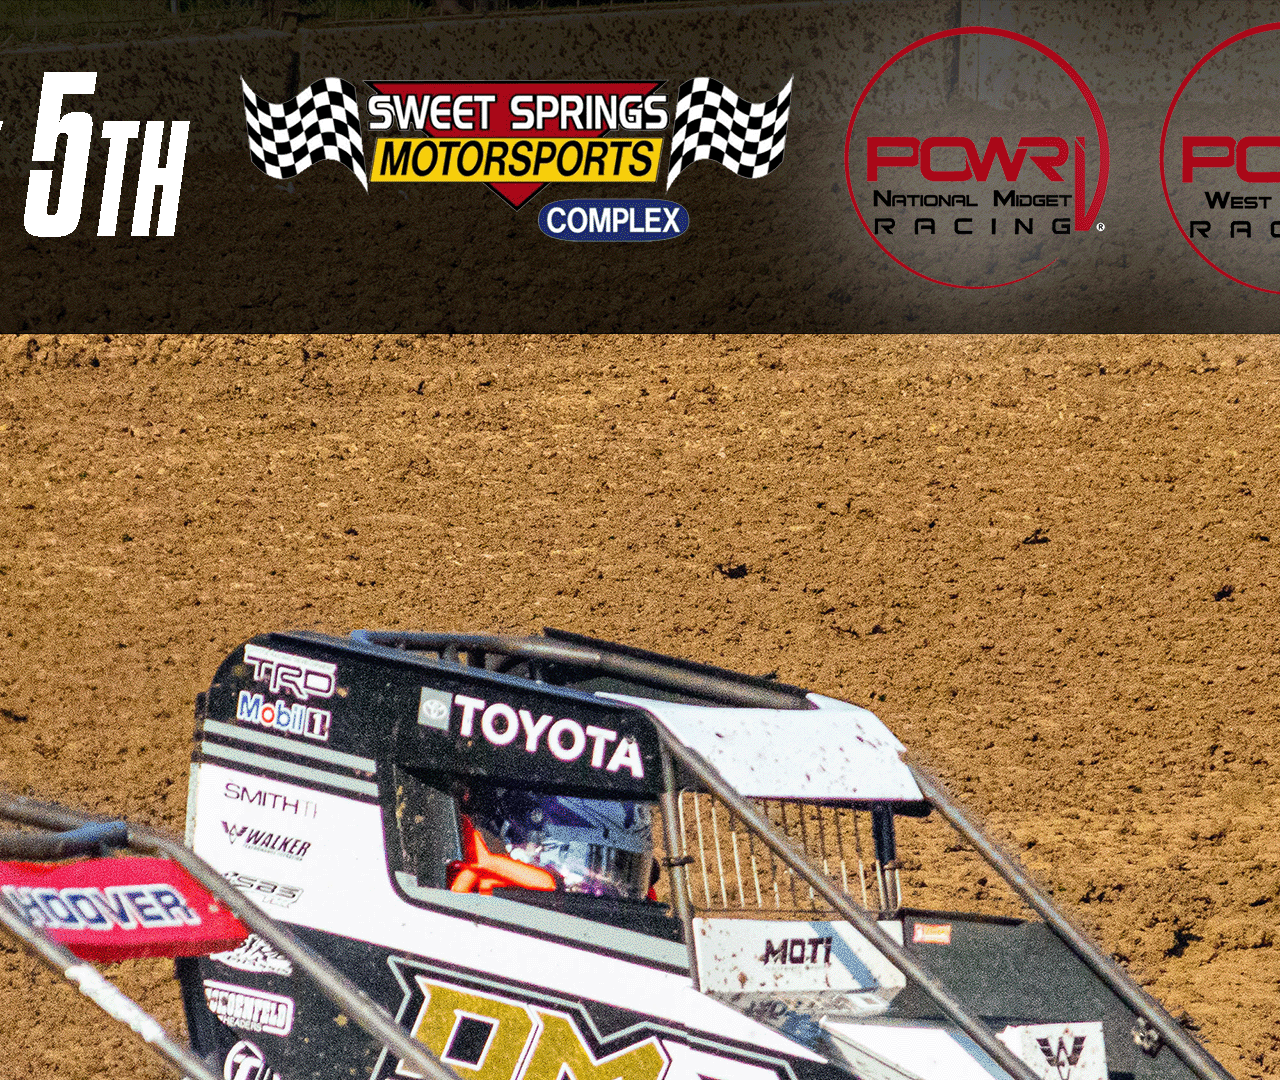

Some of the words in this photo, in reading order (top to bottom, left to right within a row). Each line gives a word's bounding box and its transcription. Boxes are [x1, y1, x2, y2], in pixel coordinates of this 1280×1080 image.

[245, 654, 336, 699] TRD
[237, 691, 305, 734] Mobil
[454, 694, 645, 779] TOYOTA
[245, 829, 311, 857] WALKER
[3, 884, 202, 931] HOOVER
[764, 937, 832, 965] MOTI
